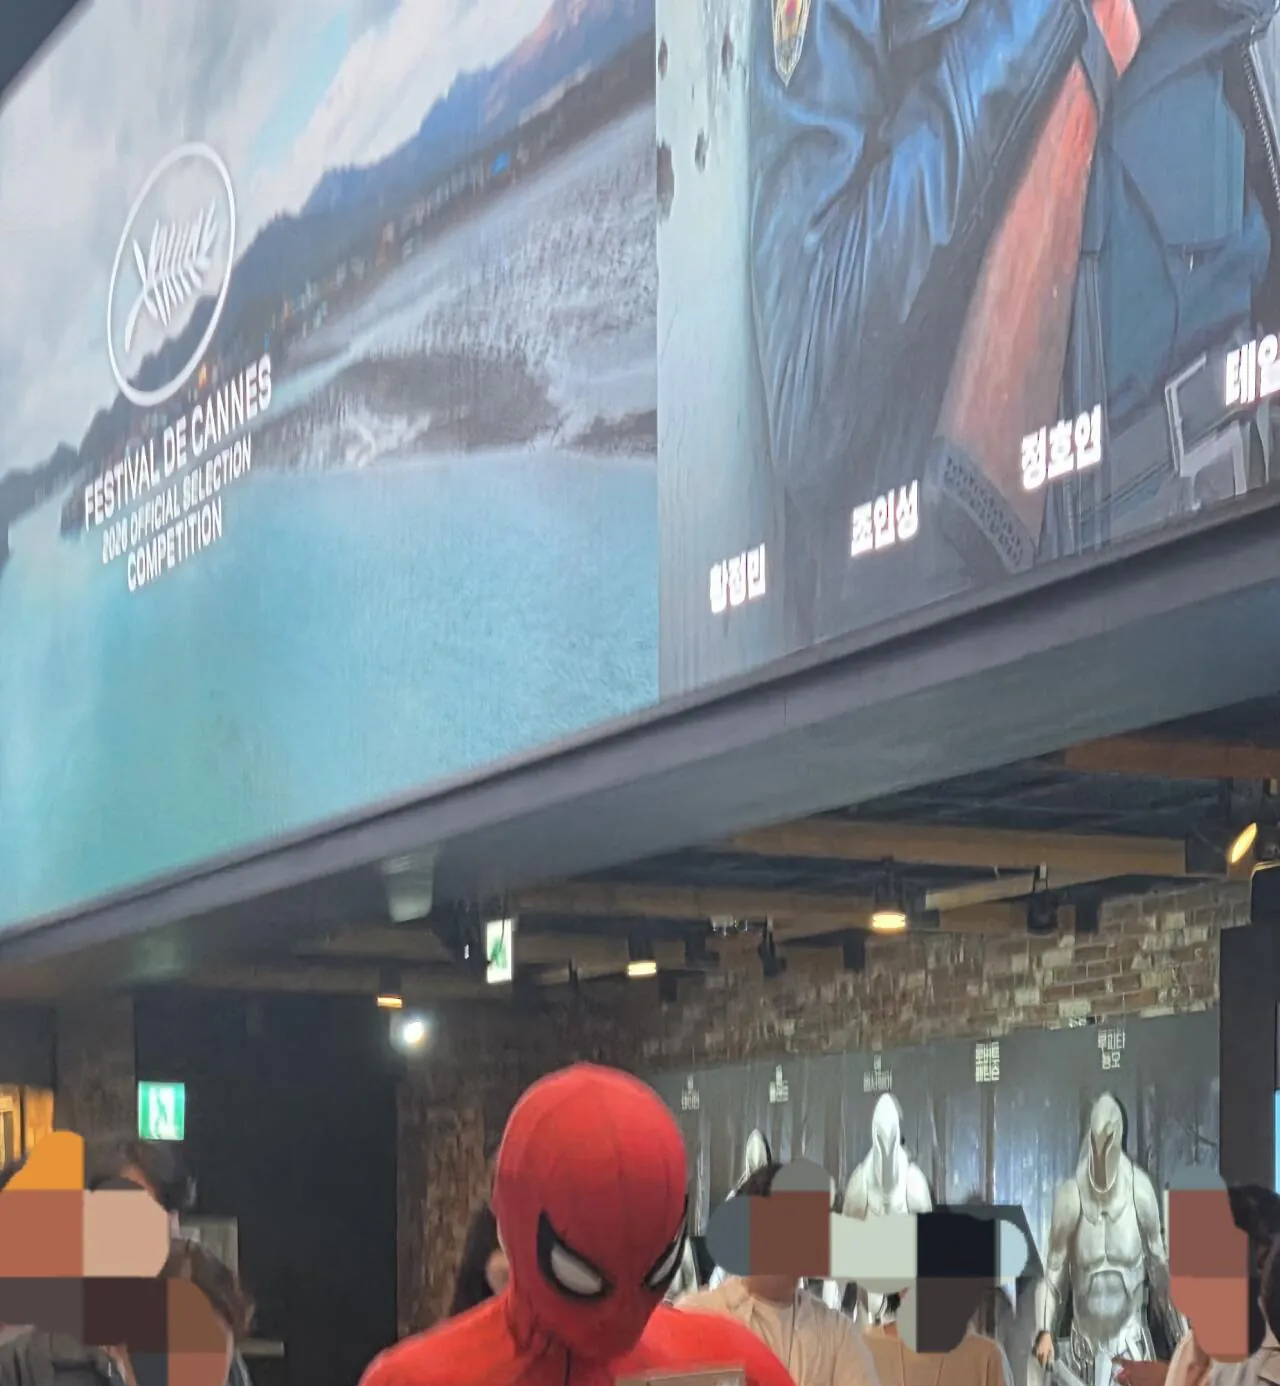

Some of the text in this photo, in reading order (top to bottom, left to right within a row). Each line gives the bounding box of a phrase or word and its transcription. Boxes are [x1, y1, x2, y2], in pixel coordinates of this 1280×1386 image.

[84, 353, 272, 532] FESTIVAL DE CANNES
[1021, 403, 1102, 490] 정호연
[102, 432, 252, 565] 2026 OFFICIAL SELECTION
[128, 496, 223, 592] COMPETITION
[851, 479, 918, 557] 조인성
